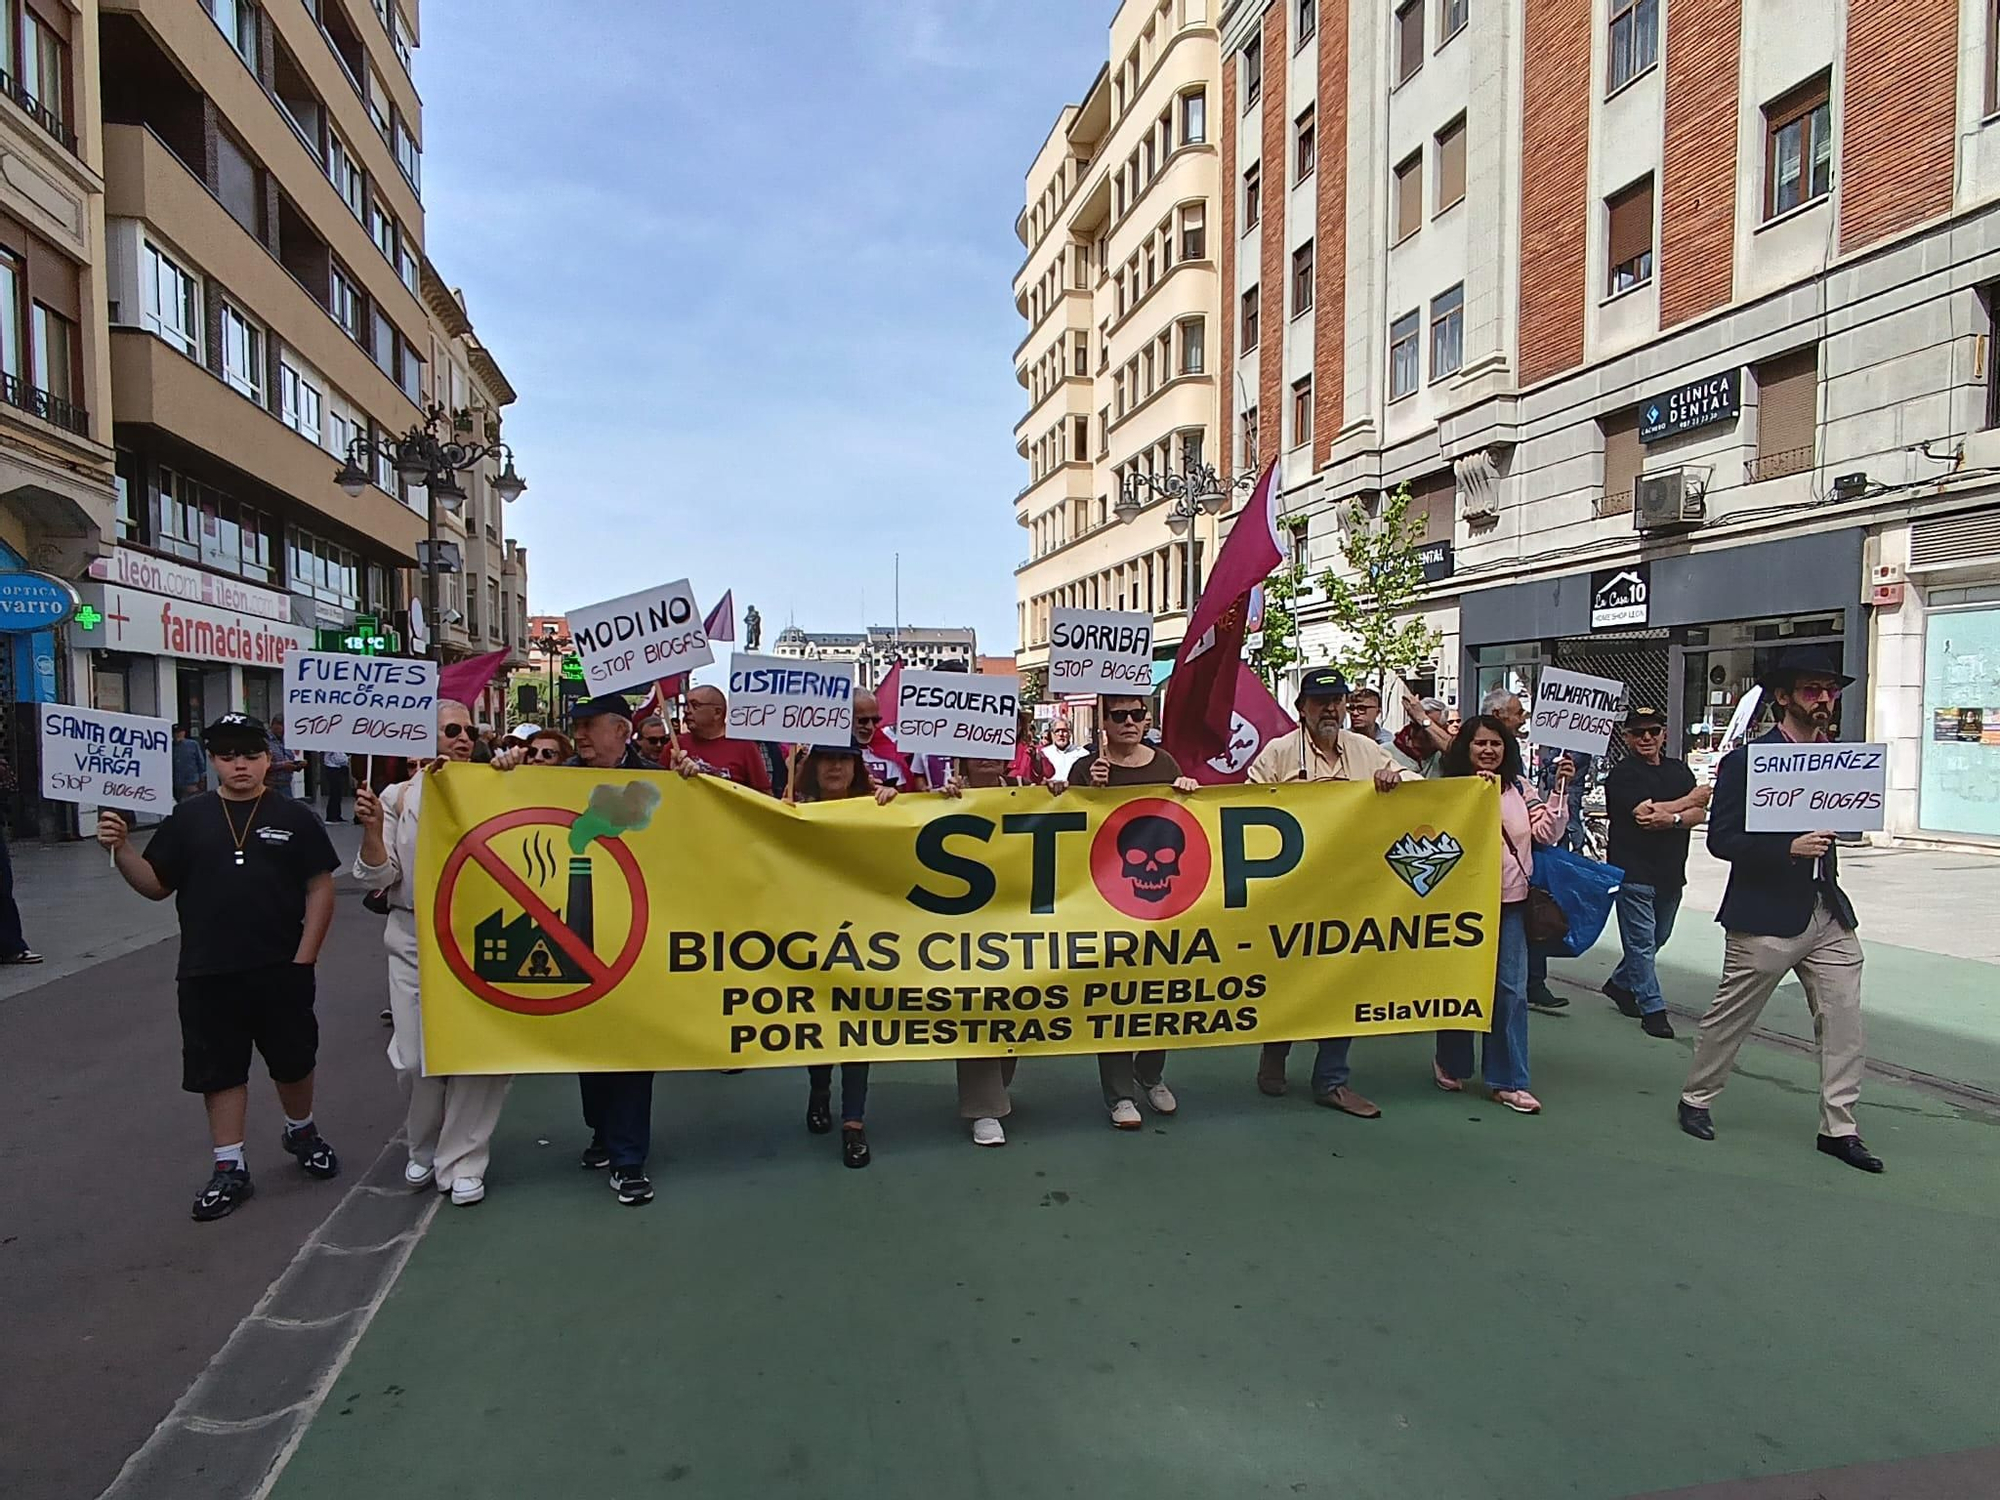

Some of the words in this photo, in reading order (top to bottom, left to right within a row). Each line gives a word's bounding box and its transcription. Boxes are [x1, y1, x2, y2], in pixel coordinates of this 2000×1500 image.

[1670, 377, 1729, 408] CLÍNICA
[1670, 393, 1729, 423] DENTAL
[117, 551, 199, 600] ileón.com
[1628, 583, 1646, 603] 10
[161, 602, 251, 660] farmacia
[1052, 622, 1150, 656] SORRIBA
[591, 650, 635, 681] STOP
[644, 630, 706, 664] BIOGAS
[298, 658, 426, 685] FUENTES
[729, 669, 851, 700] CISTIERNA
[1053, 659, 1093, 678] STOP
[1101, 660, 1153, 686] BIOGAS
[289, 688, 433, 710] PEÑACORADA
[357, 683, 374, 693] DE
[900, 685, 1016, 717] PESQUERA
[220, 713, 247, 724] NY
[294, 714, 342, 735] STOP
[352, 717, 428, 741] BIOGAS
[730, 704, 776, 726] STOP
[782, 705, 851, 729] BIOGAS
[1536, 709, 1569, 729] STOP
[1569, 712, 1613, 736] BIOGAS
[46, 714, 105, 744] SANTA
[109, 726, 168, 753] OLAJA
[900, 719, 947, 737] STOP
[953, 723, 1016, 746] BIOGAS
[87, 743, 106, 757] DE
[113, 746, 133, 759] LA
[1753, 750, 1882, 773] SANTIBAÑEZ
[75, 753, 141, 777] VARGA
[51, 773, 92, 791] STOP
[103, 781, 157, 801] BIOGAS
[1753, 787, 1805, 807] STOP
[1809, 791, 1881, 810] BIOGAS
[669, 921, 900, 973] BIOGÁS
[918, 928, 1221, 972] CISTIERNA
[1268, 911, 1484, 959] VIDANES
[723, 986, 816, 1016] POR
[831, 985, 1069, 1013] NUESTROS
[1084, 974, 1266, 1007] PUEBLOS
[1355, 998, 1483, 1023] EslaVIDA
[730, 1023, 824, 1054] POR
[839, 1016, 1072, 1048] NUESTRAS
[1086, 1007, 1259, 1040] TIERRAS
